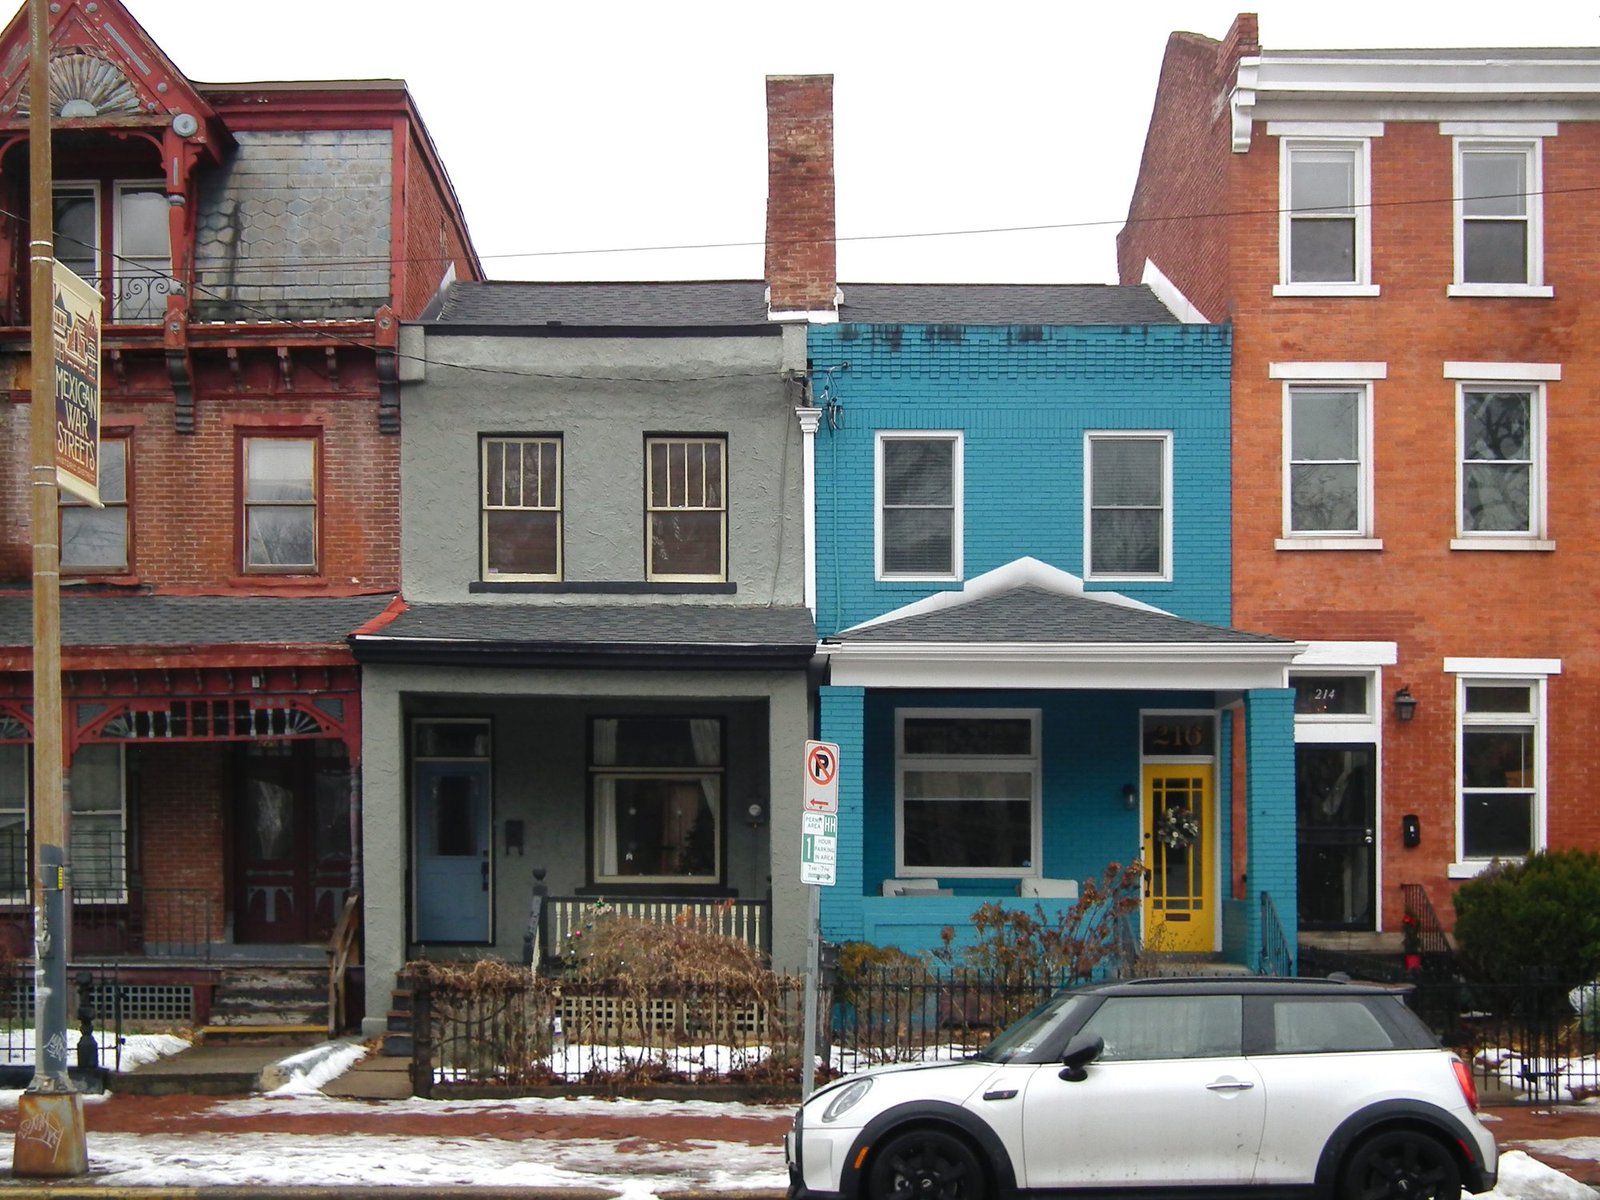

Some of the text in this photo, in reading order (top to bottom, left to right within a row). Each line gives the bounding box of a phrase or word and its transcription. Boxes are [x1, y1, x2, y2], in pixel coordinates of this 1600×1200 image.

[55, 365, 97, 421] MEXICAN
[65, 400, 88, 439] WAR
[57, 421, 95, 471] STREETS
[1314, 688, 1335, 699] 214
[1153, 723, 1201, 746] 216
[806, 816, 823, 824] PERM
[825, 816, 836, 833] HH
[806, 837, 811, 859] 1
